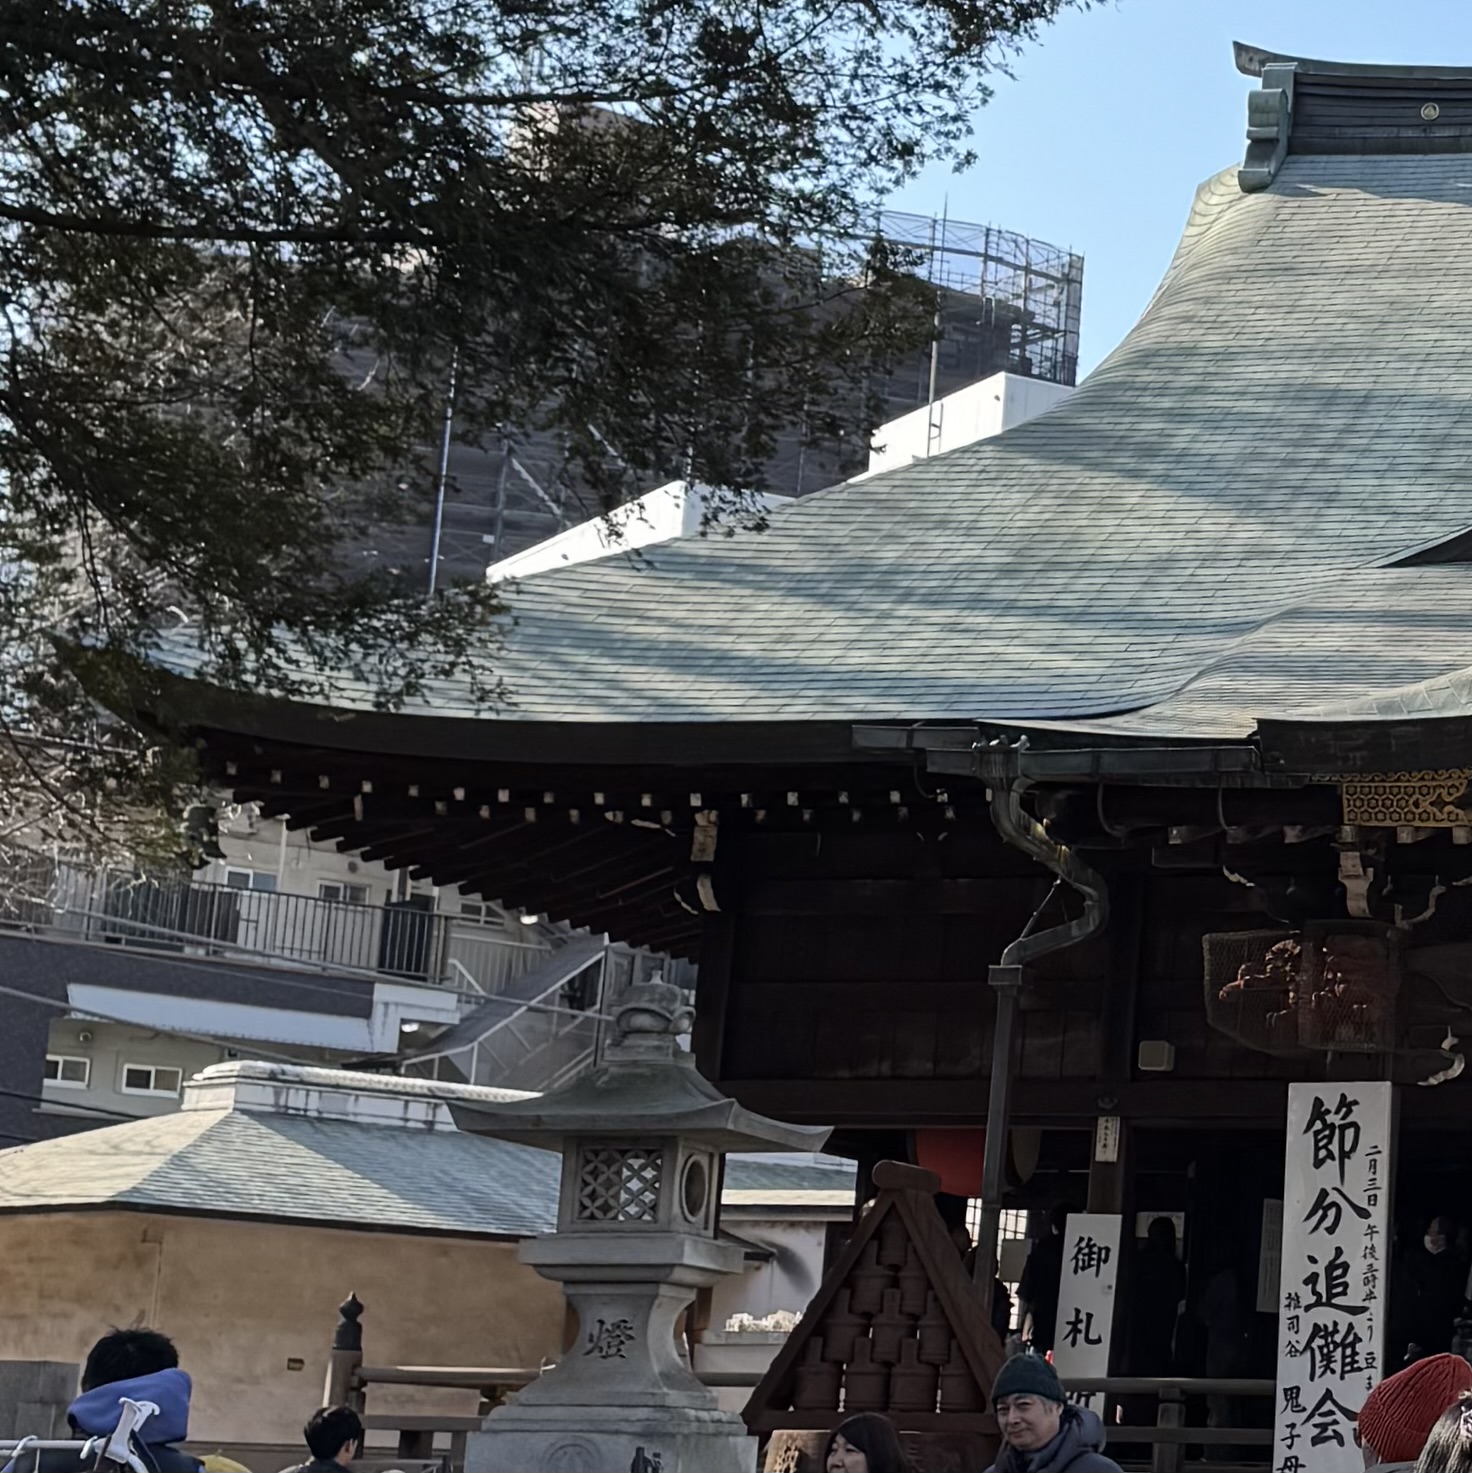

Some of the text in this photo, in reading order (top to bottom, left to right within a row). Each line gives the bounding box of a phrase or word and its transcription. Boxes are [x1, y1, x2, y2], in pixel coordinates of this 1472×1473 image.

[1363, 1145, 1383, 1207] 二月三日
[1302, 1092, 1372, 1447] 節分追儺会
[583, 1319, 636, 1359] 燈
